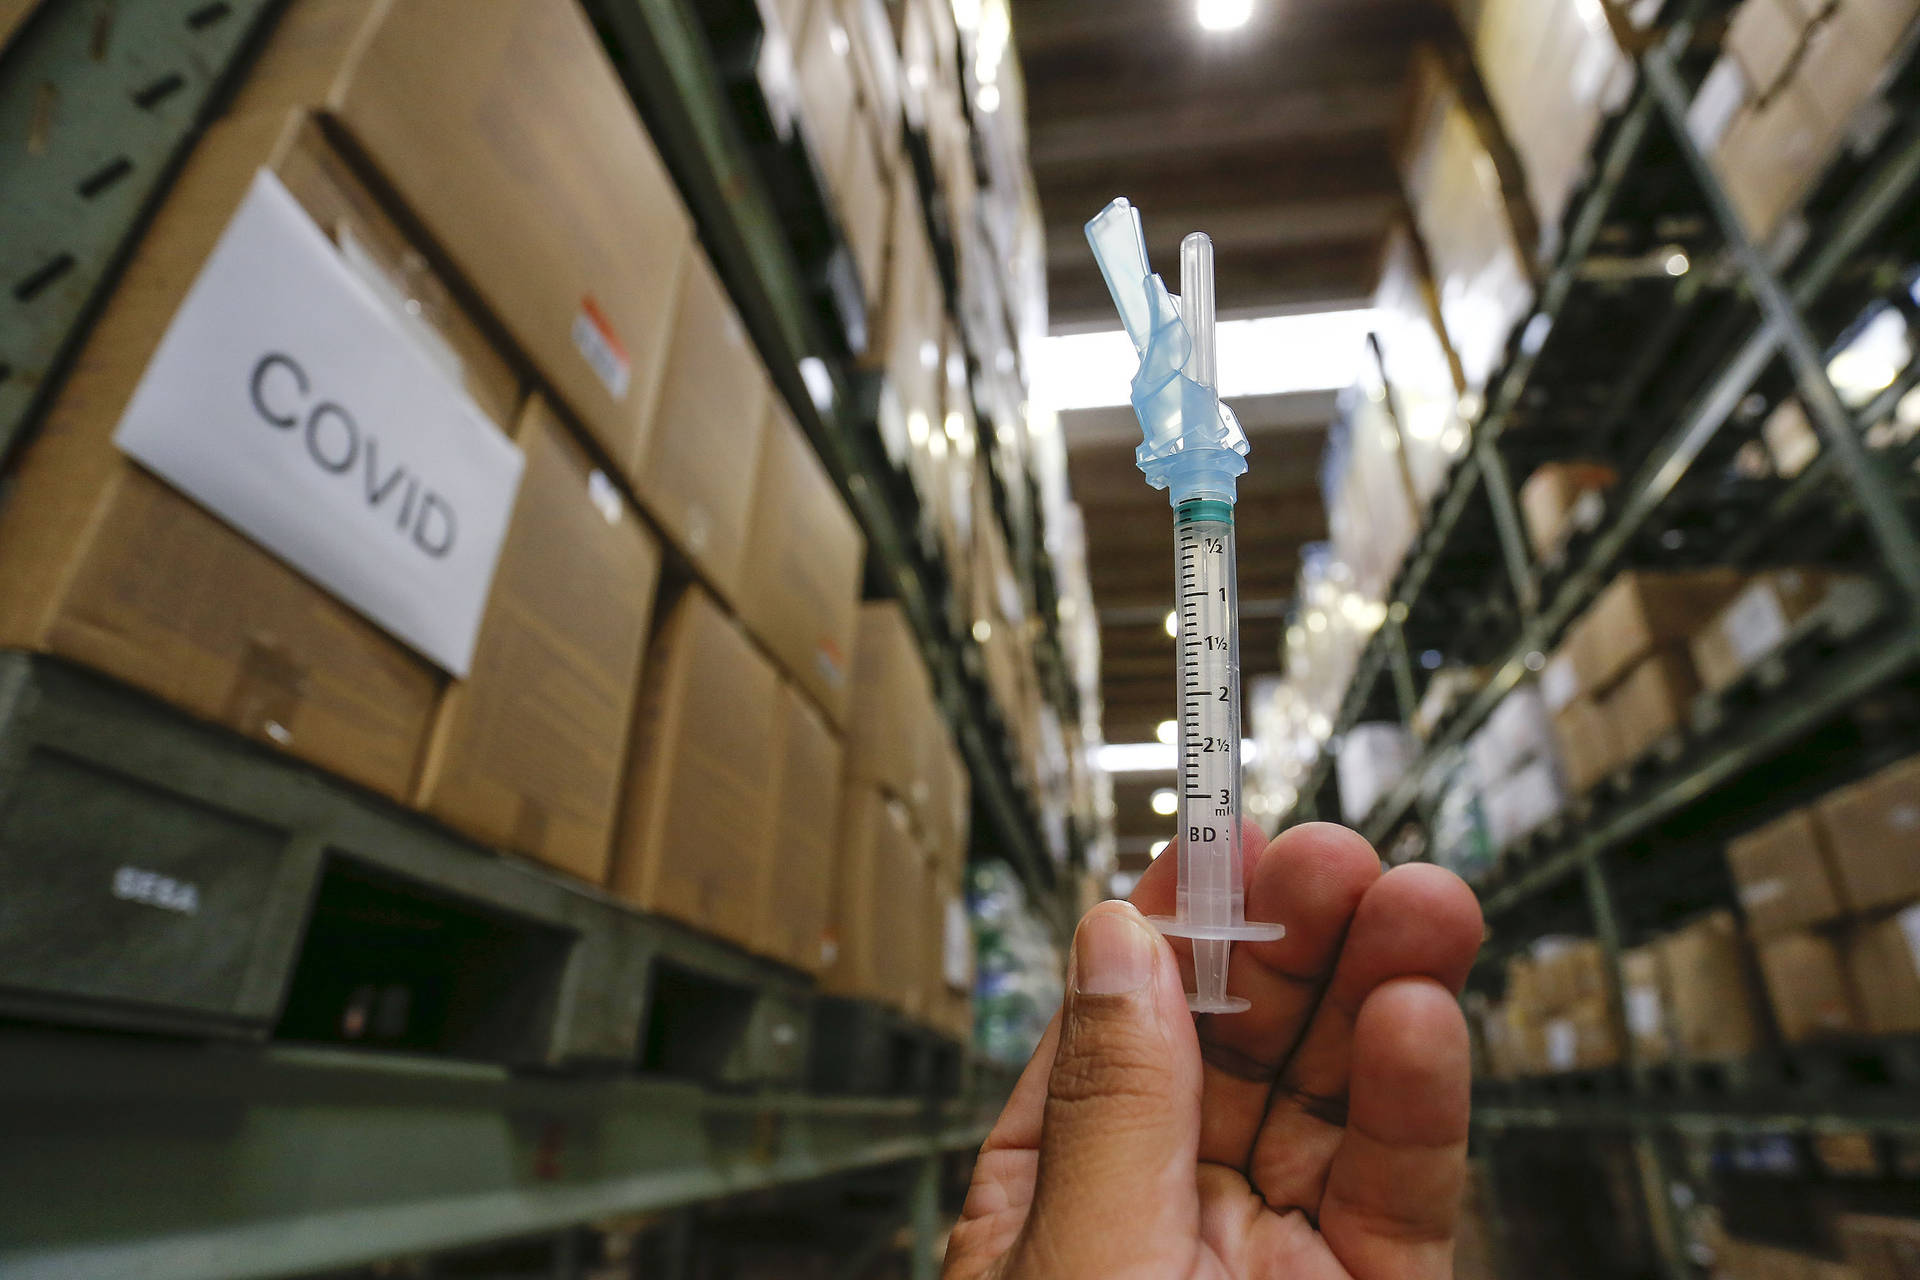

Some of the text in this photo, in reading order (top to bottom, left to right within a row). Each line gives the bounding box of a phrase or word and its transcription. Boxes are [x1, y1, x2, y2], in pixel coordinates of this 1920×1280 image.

[250, 352, 459, 559] COVID
[1218, 587, 1226, 602] 1
[1218, 685, 1230, 702] 2
[1219, 788, 1230, 805] 3
[1189, 826, 1217, 842] BD
